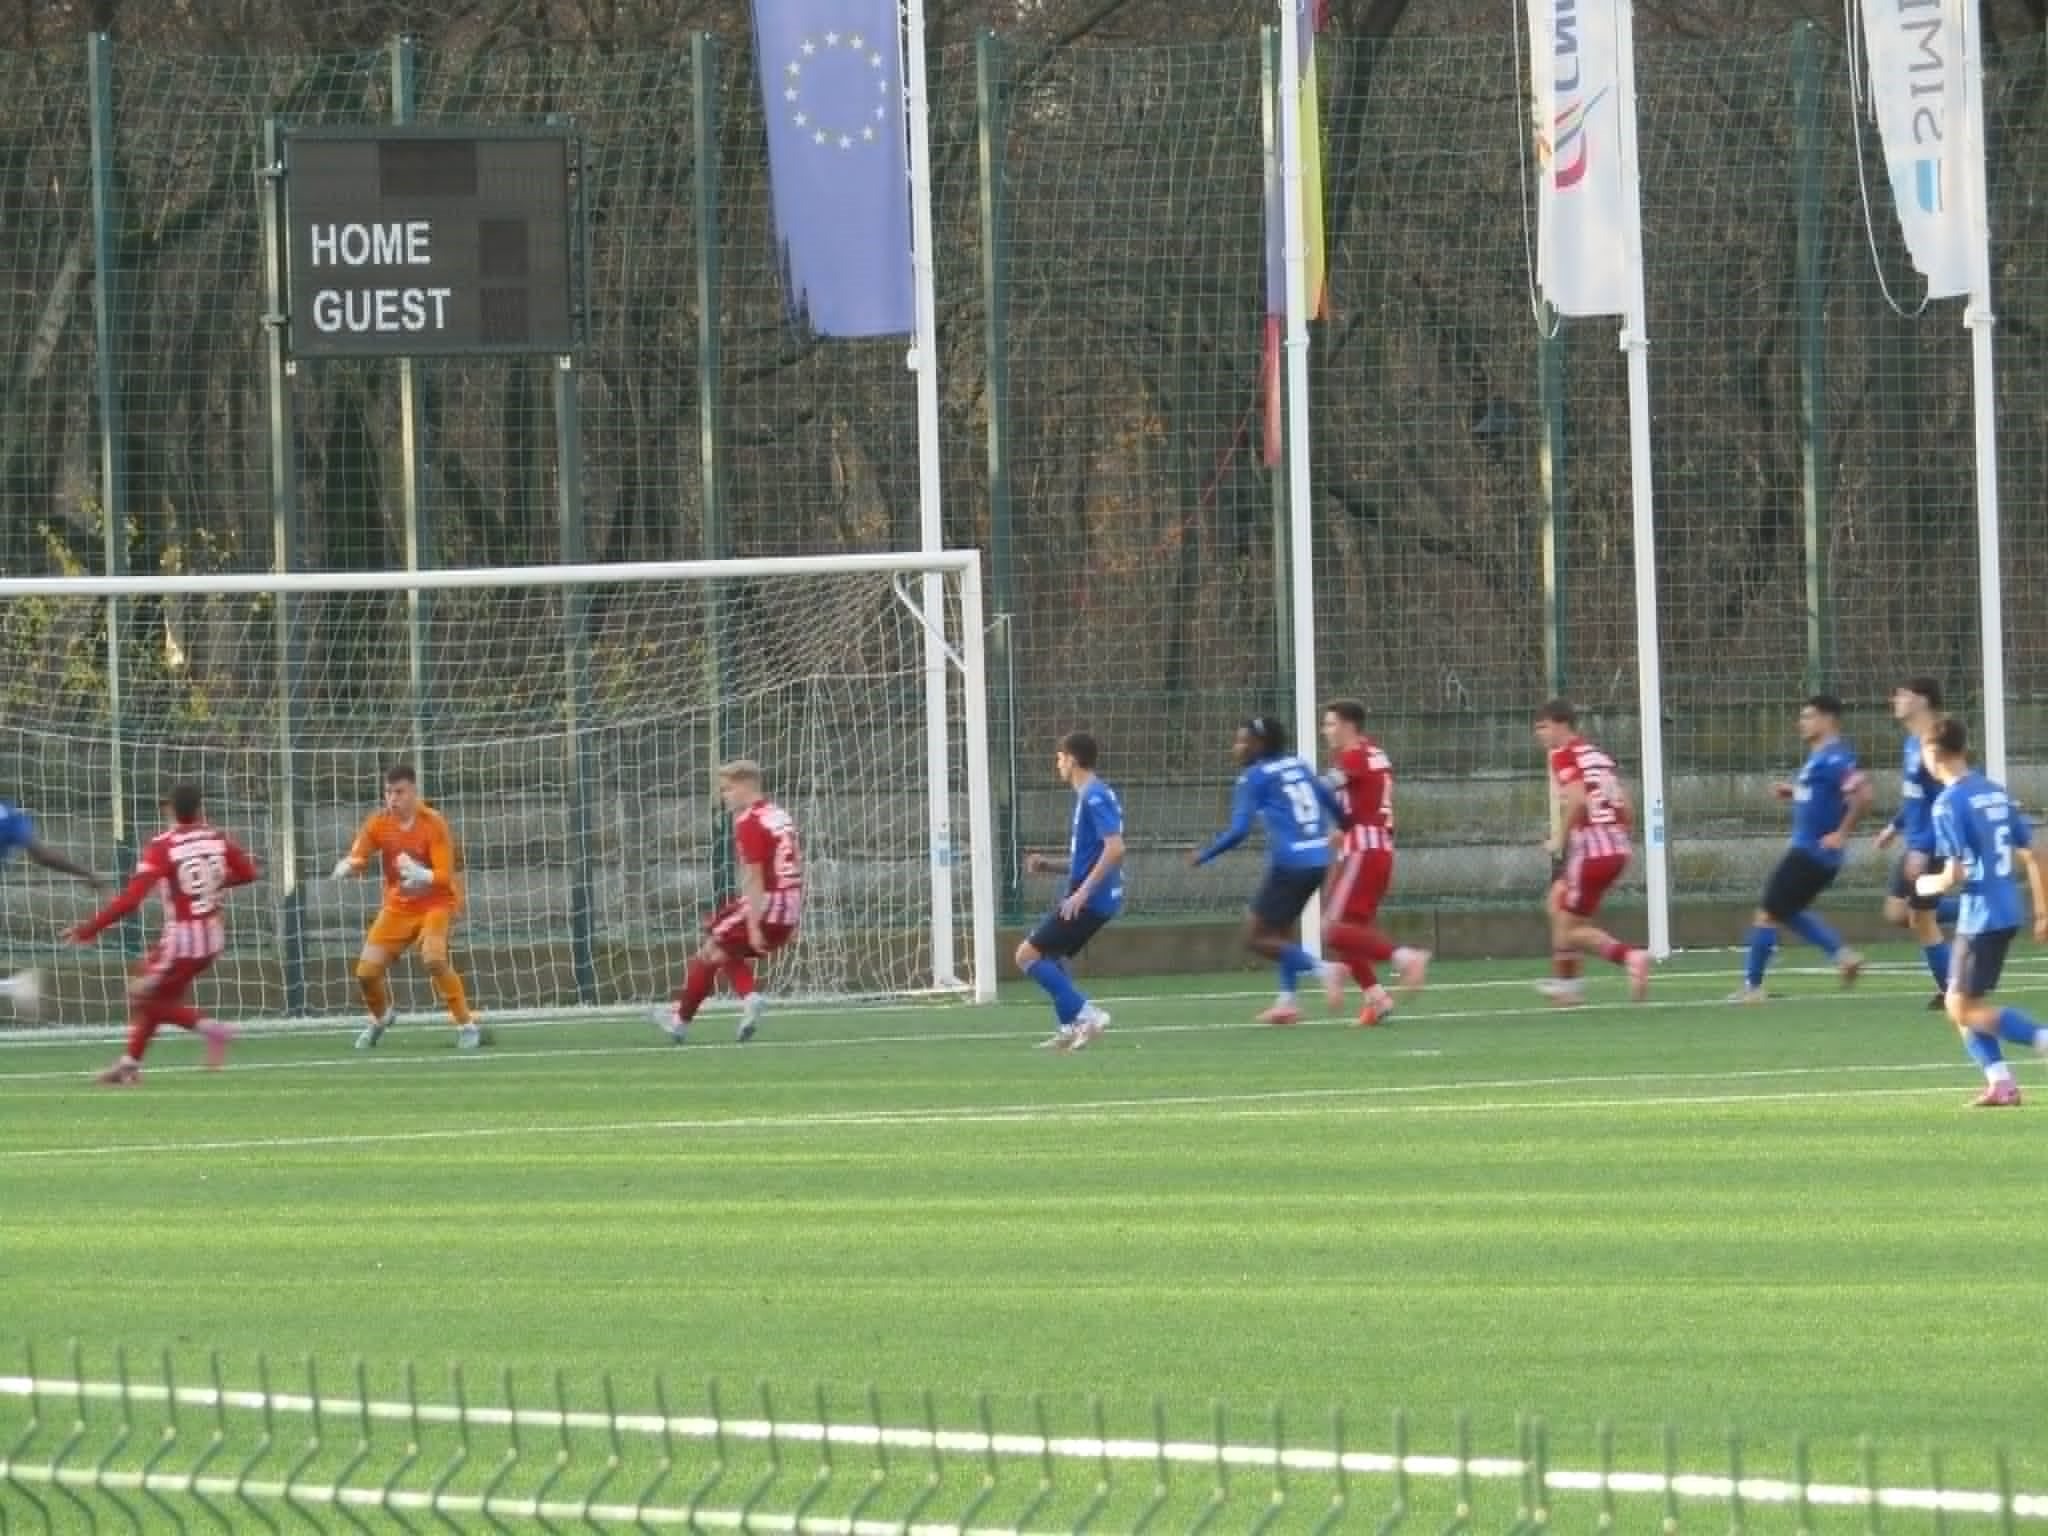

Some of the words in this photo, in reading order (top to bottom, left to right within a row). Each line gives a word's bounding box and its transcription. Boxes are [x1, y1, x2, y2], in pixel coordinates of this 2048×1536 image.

[311, 221, 431, 265] HOME
[313, 288, 451, 332] GUEST
[1994, 825, 2012, 877] 5
